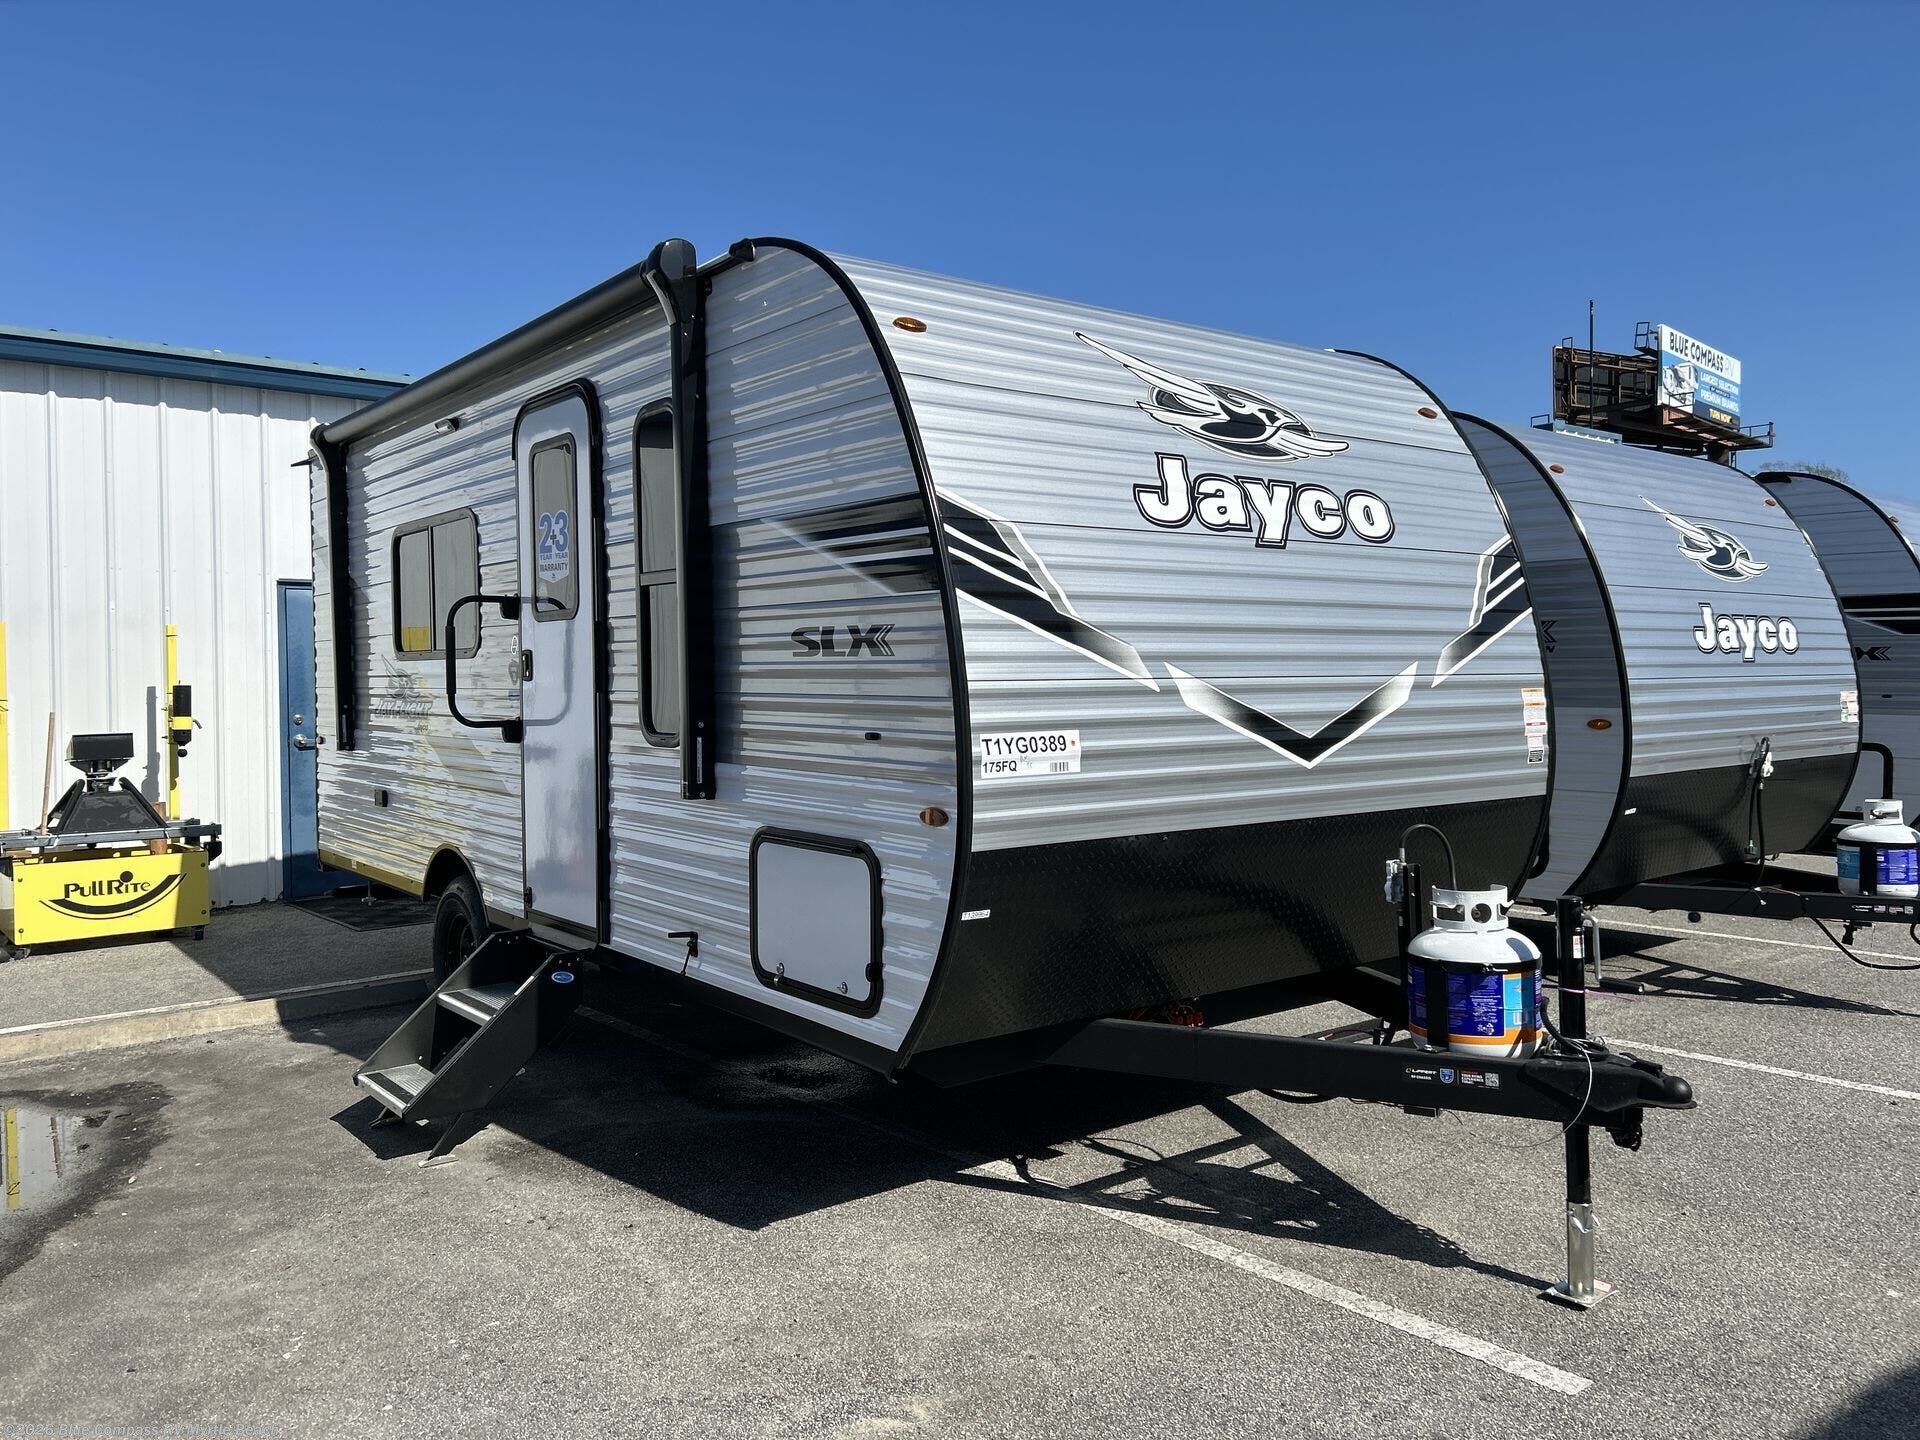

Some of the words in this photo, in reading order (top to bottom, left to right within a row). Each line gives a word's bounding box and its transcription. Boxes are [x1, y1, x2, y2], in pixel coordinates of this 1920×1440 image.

[1669, 331, 1689, 357] BLUE
[1690, 341, 1724, 373] COMPASS
[1132, 452, 1395, 549] Jayco
[540, 562, 569, 573] WARRANTY
[790, 623, 896, 657] SLX
[1693, 602, 1799, 663] Jayco
[981, 734, 1067, 756] T1YG0389
[982, 760, 1018, 773] 175FQ
